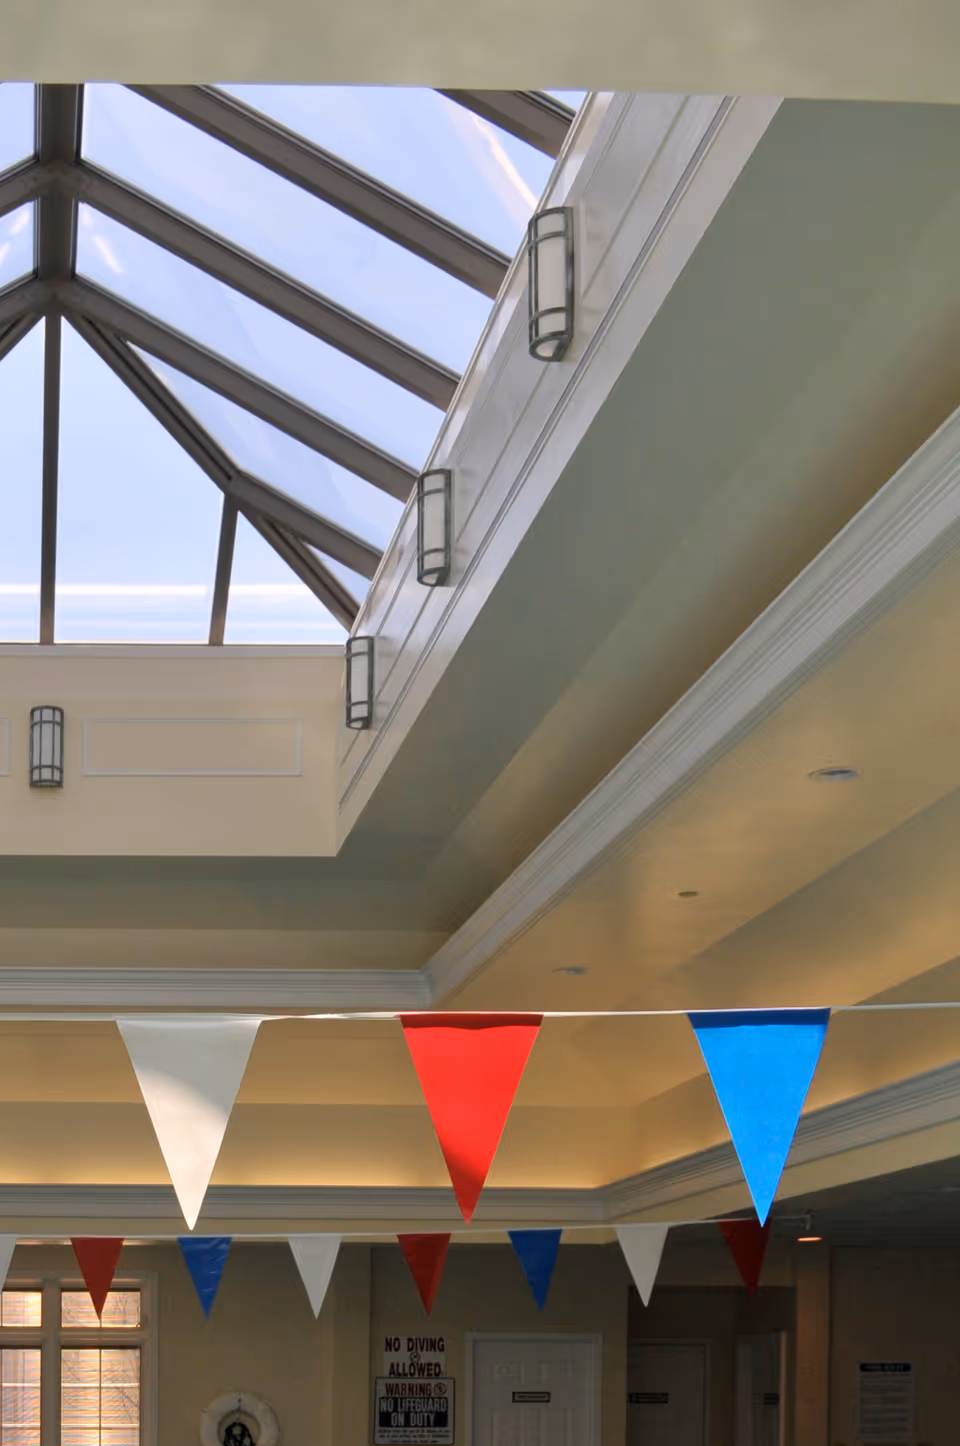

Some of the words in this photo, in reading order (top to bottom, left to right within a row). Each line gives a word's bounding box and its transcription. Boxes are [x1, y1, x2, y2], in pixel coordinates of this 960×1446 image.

[384, 1337, 400, 1352] NO
[407, 1337, 445, 1352] DIVING
[388, 1363, 441, 1377] ALLOWED
[385, 1383, 432, 1396] WARNING
[380, 1398, 393, 1412] NO
[398, 1398, 447, 1412] LIFEGUARD
[391, 1413, 404, 1427] ON
[410, 1413, 435, 1427] DUTY
